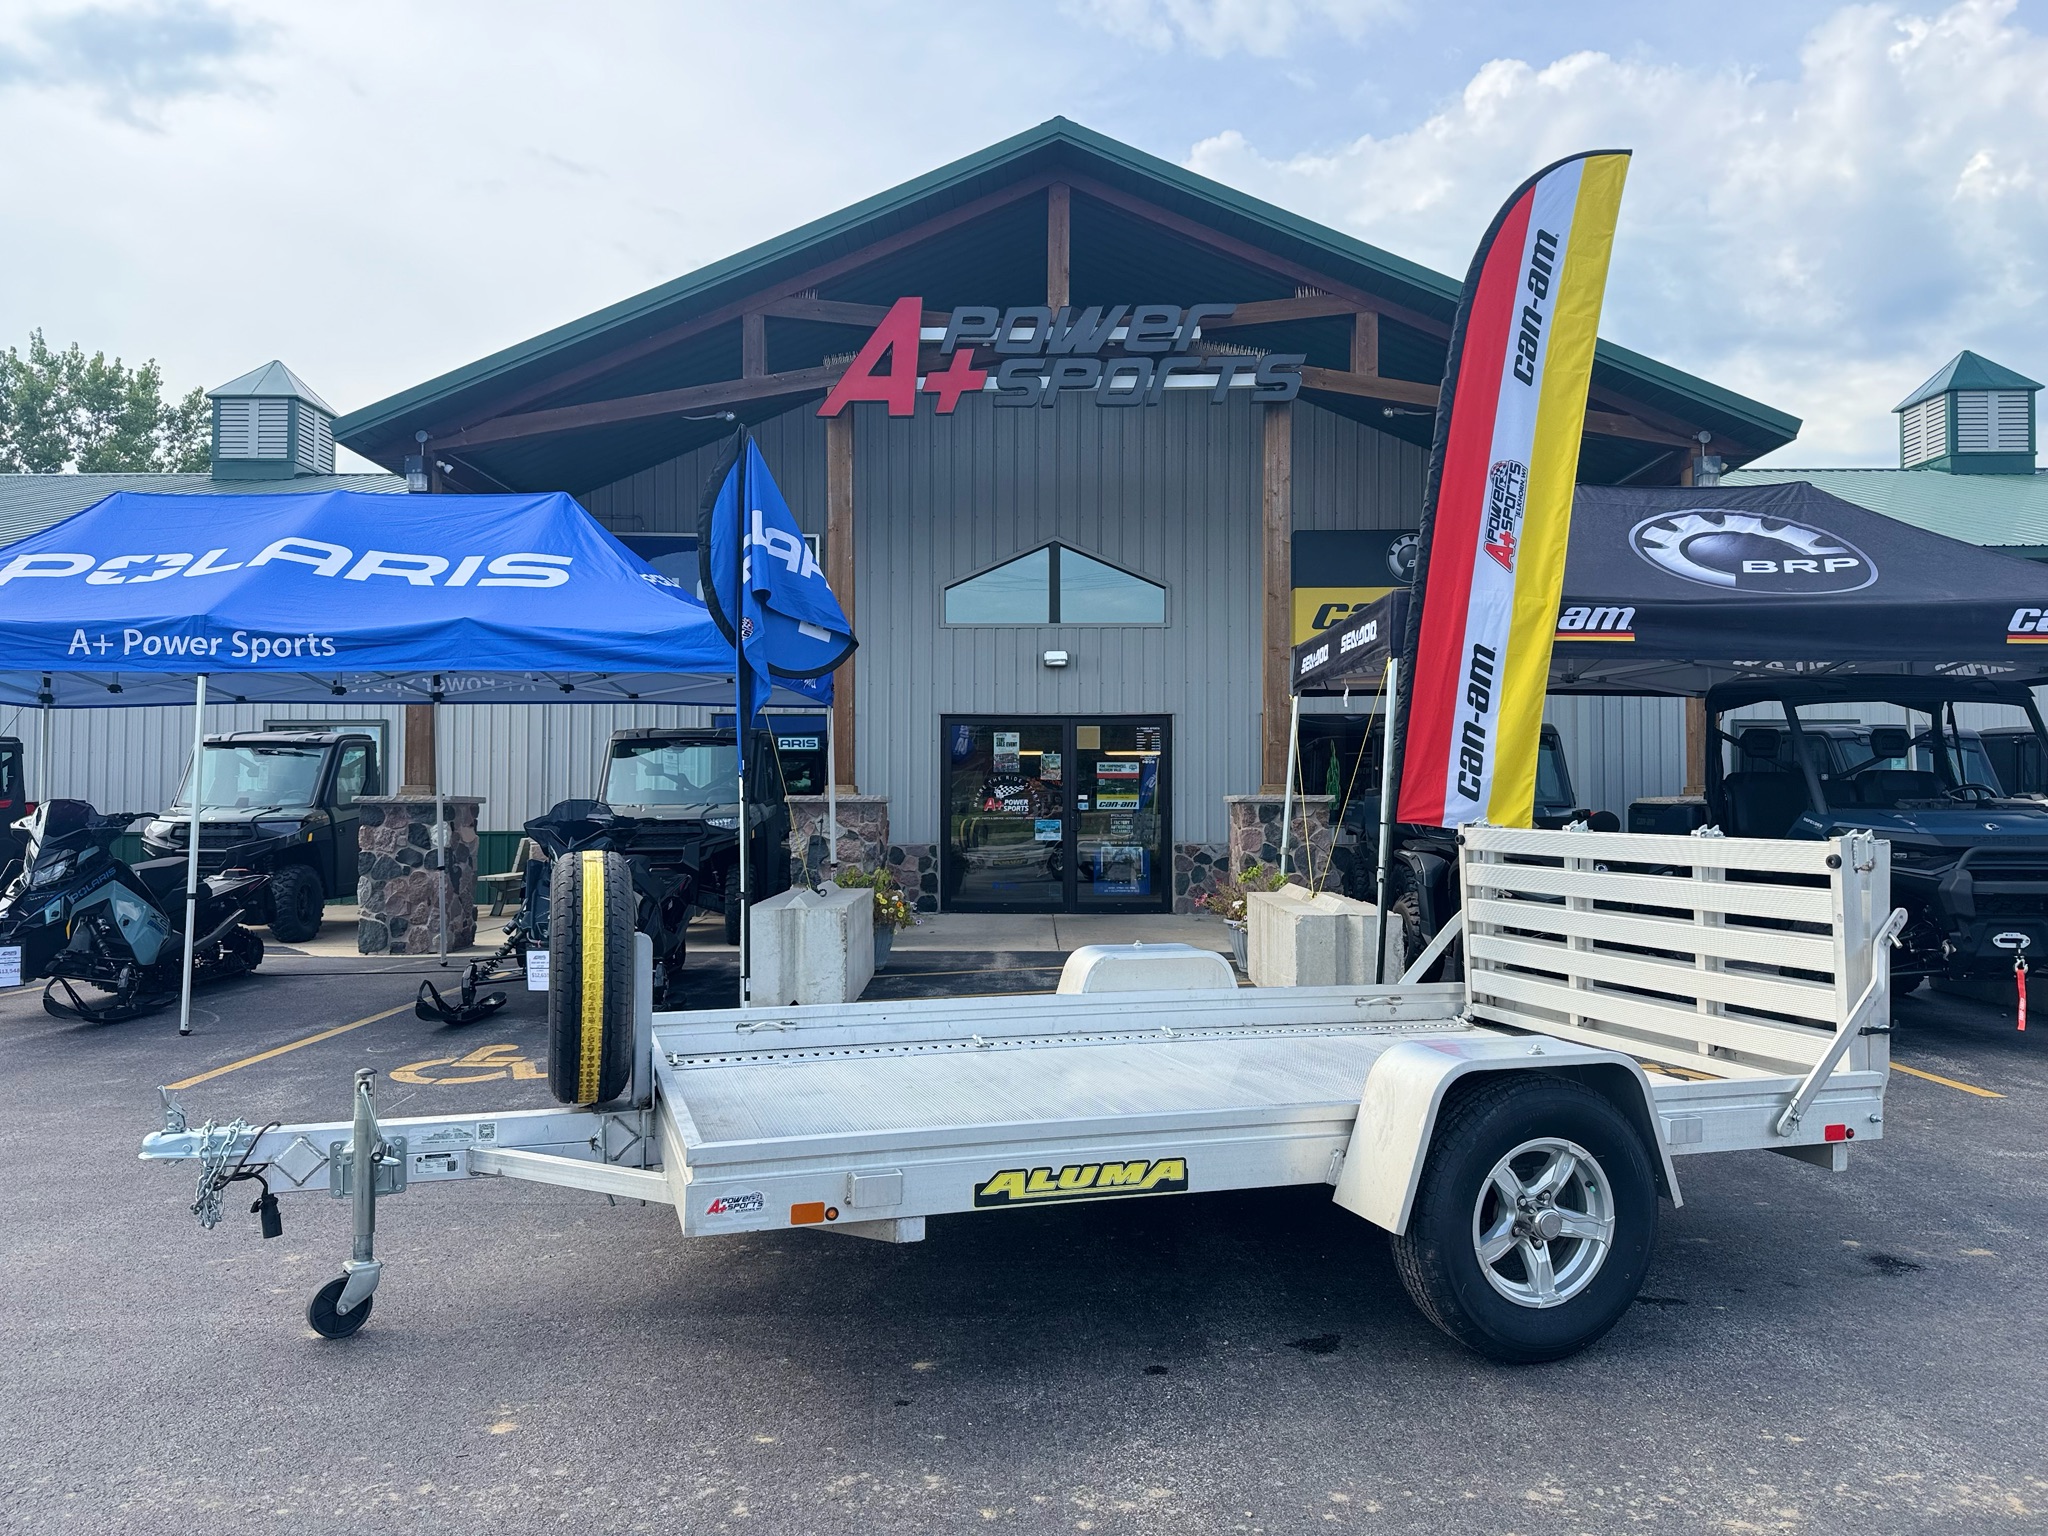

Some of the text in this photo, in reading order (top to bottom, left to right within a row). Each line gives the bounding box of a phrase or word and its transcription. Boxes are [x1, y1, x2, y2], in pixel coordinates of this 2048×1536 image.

[1514, 229, 1559, 387] can-am
[816, 297, 988, 418] A+
[0, 537, 574, 588] POLARIS
[1485, 531, 1516, 572] A+
[1742, 557, 1860, 574] BRP
[68, 628, 337, 663] A+ Power Sports
[1457, 643, 1496, 803] can-am
[779, 738, 817, 749] ARIS
[1005, 775, 1022, 783] RIDE
[983, 797, 1005, 812] A+
[66, 867, 117, 904] POLARIS
[980, 1158, 1186, 1198] ALUMA
[706, 1198, 728, 1215] A+
